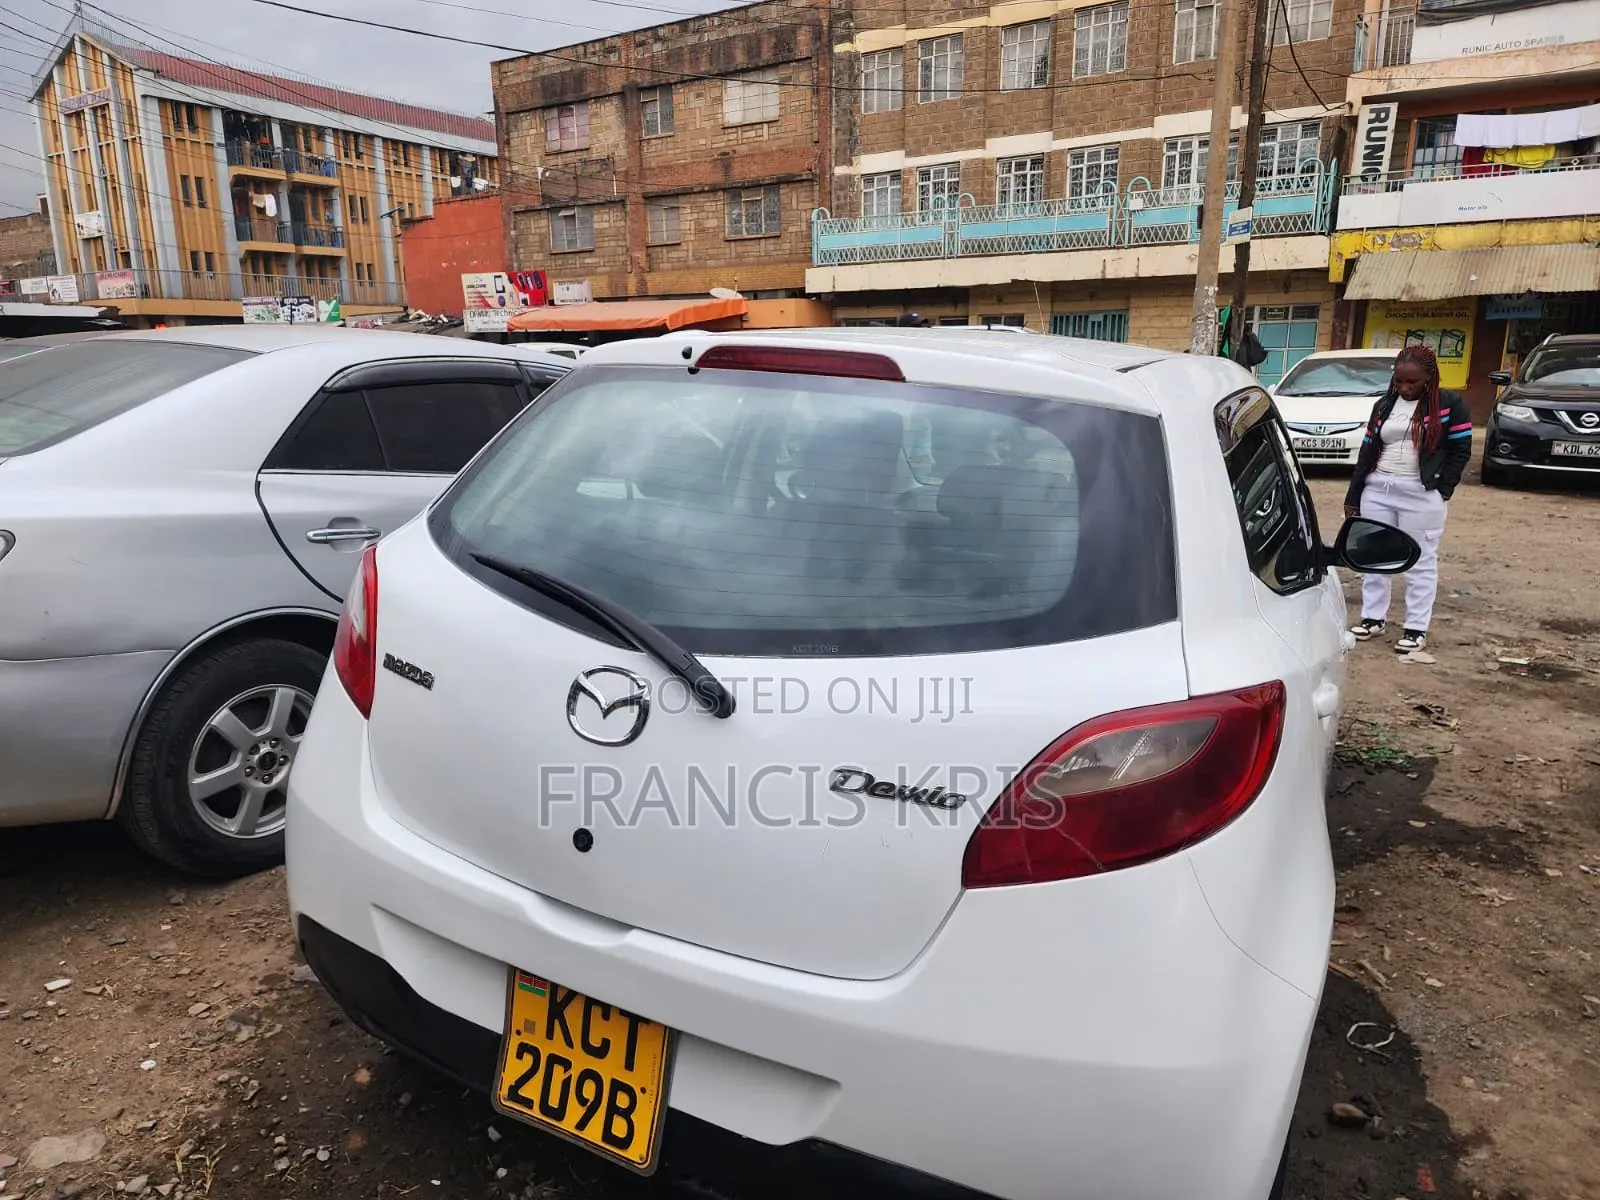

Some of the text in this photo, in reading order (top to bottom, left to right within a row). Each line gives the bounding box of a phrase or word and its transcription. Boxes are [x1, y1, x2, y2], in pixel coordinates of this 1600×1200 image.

[1462, 45, 1492, 55] RUNIC
[1494, 40, 1521, 50] AUTO
[1360, 106, 1391, 183] RUNIC
[1301, 439, 1342, 448] KCS 891N
[1563, 443, 1583, 455] KDL
[546, 981, 650, 1072] KCT
[507, 1041, 637, 1151] 209B
